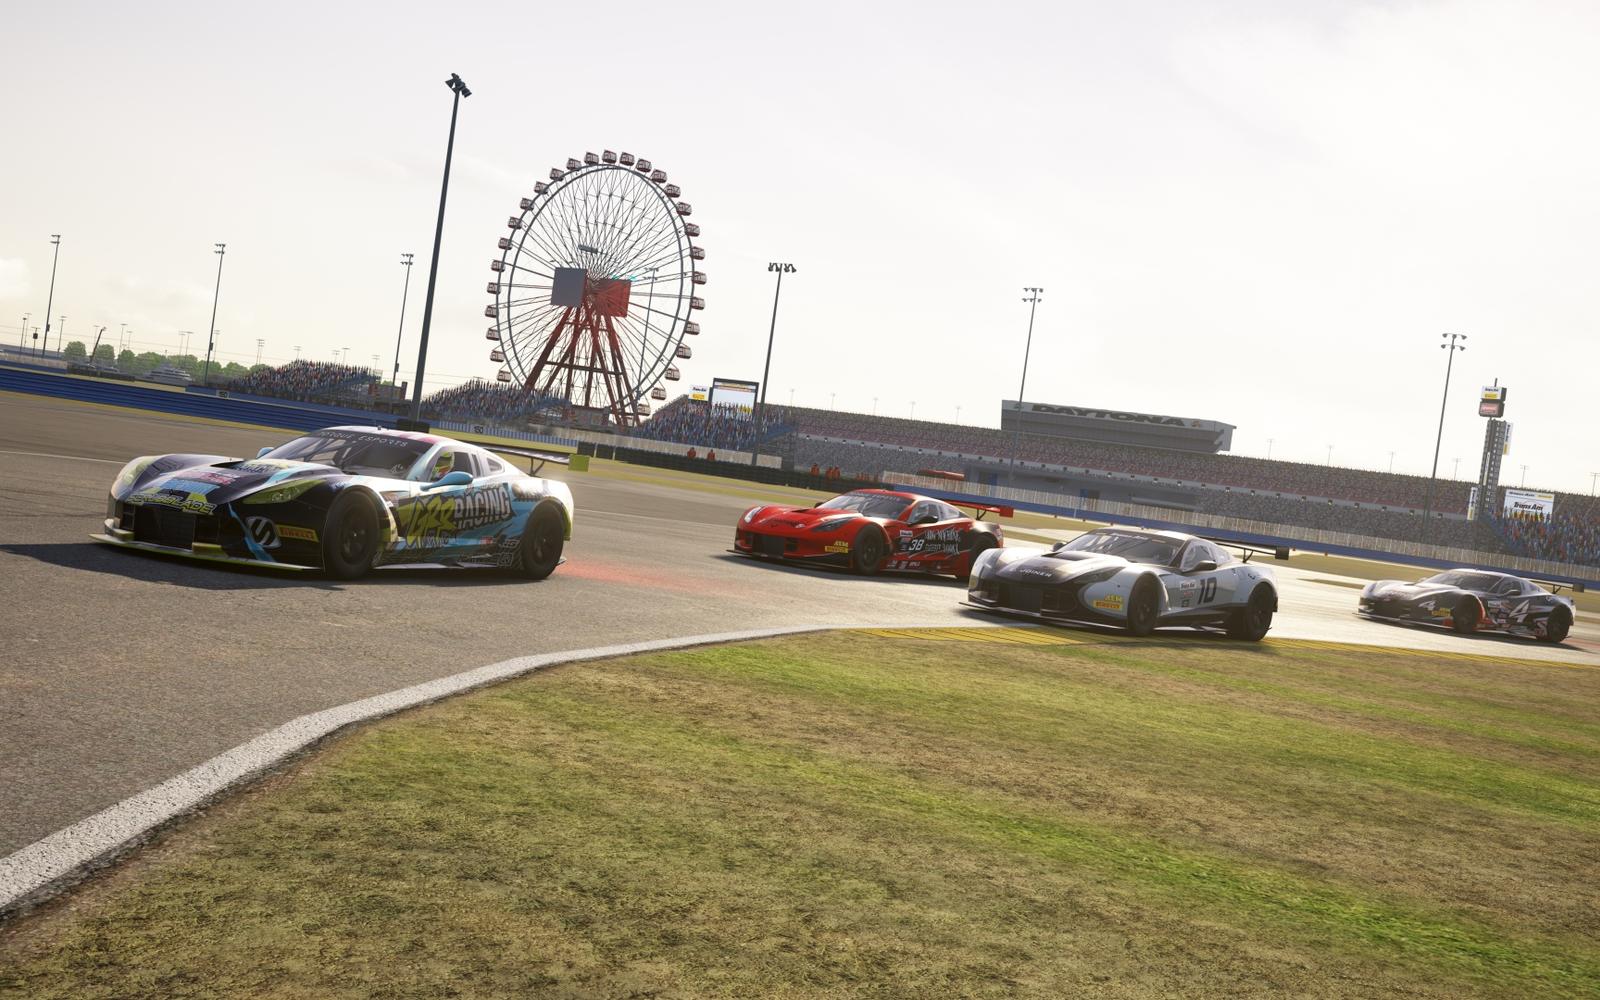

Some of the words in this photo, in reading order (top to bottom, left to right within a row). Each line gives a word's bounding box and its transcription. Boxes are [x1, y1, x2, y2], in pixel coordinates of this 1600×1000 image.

[1031, 403, 1185, 427] DAYTONA
[358, 434, 408, 447] ESPORTS
[454, 485, 511, 529] RACING
[1532, 503, 1544, 511] Am
[908, 539, 925, 551] 38
[1020, 568, 1053, 578] JOINER
[1198, 577, 1217, 605] 10
[1509, 600, 1530, 623] 4
